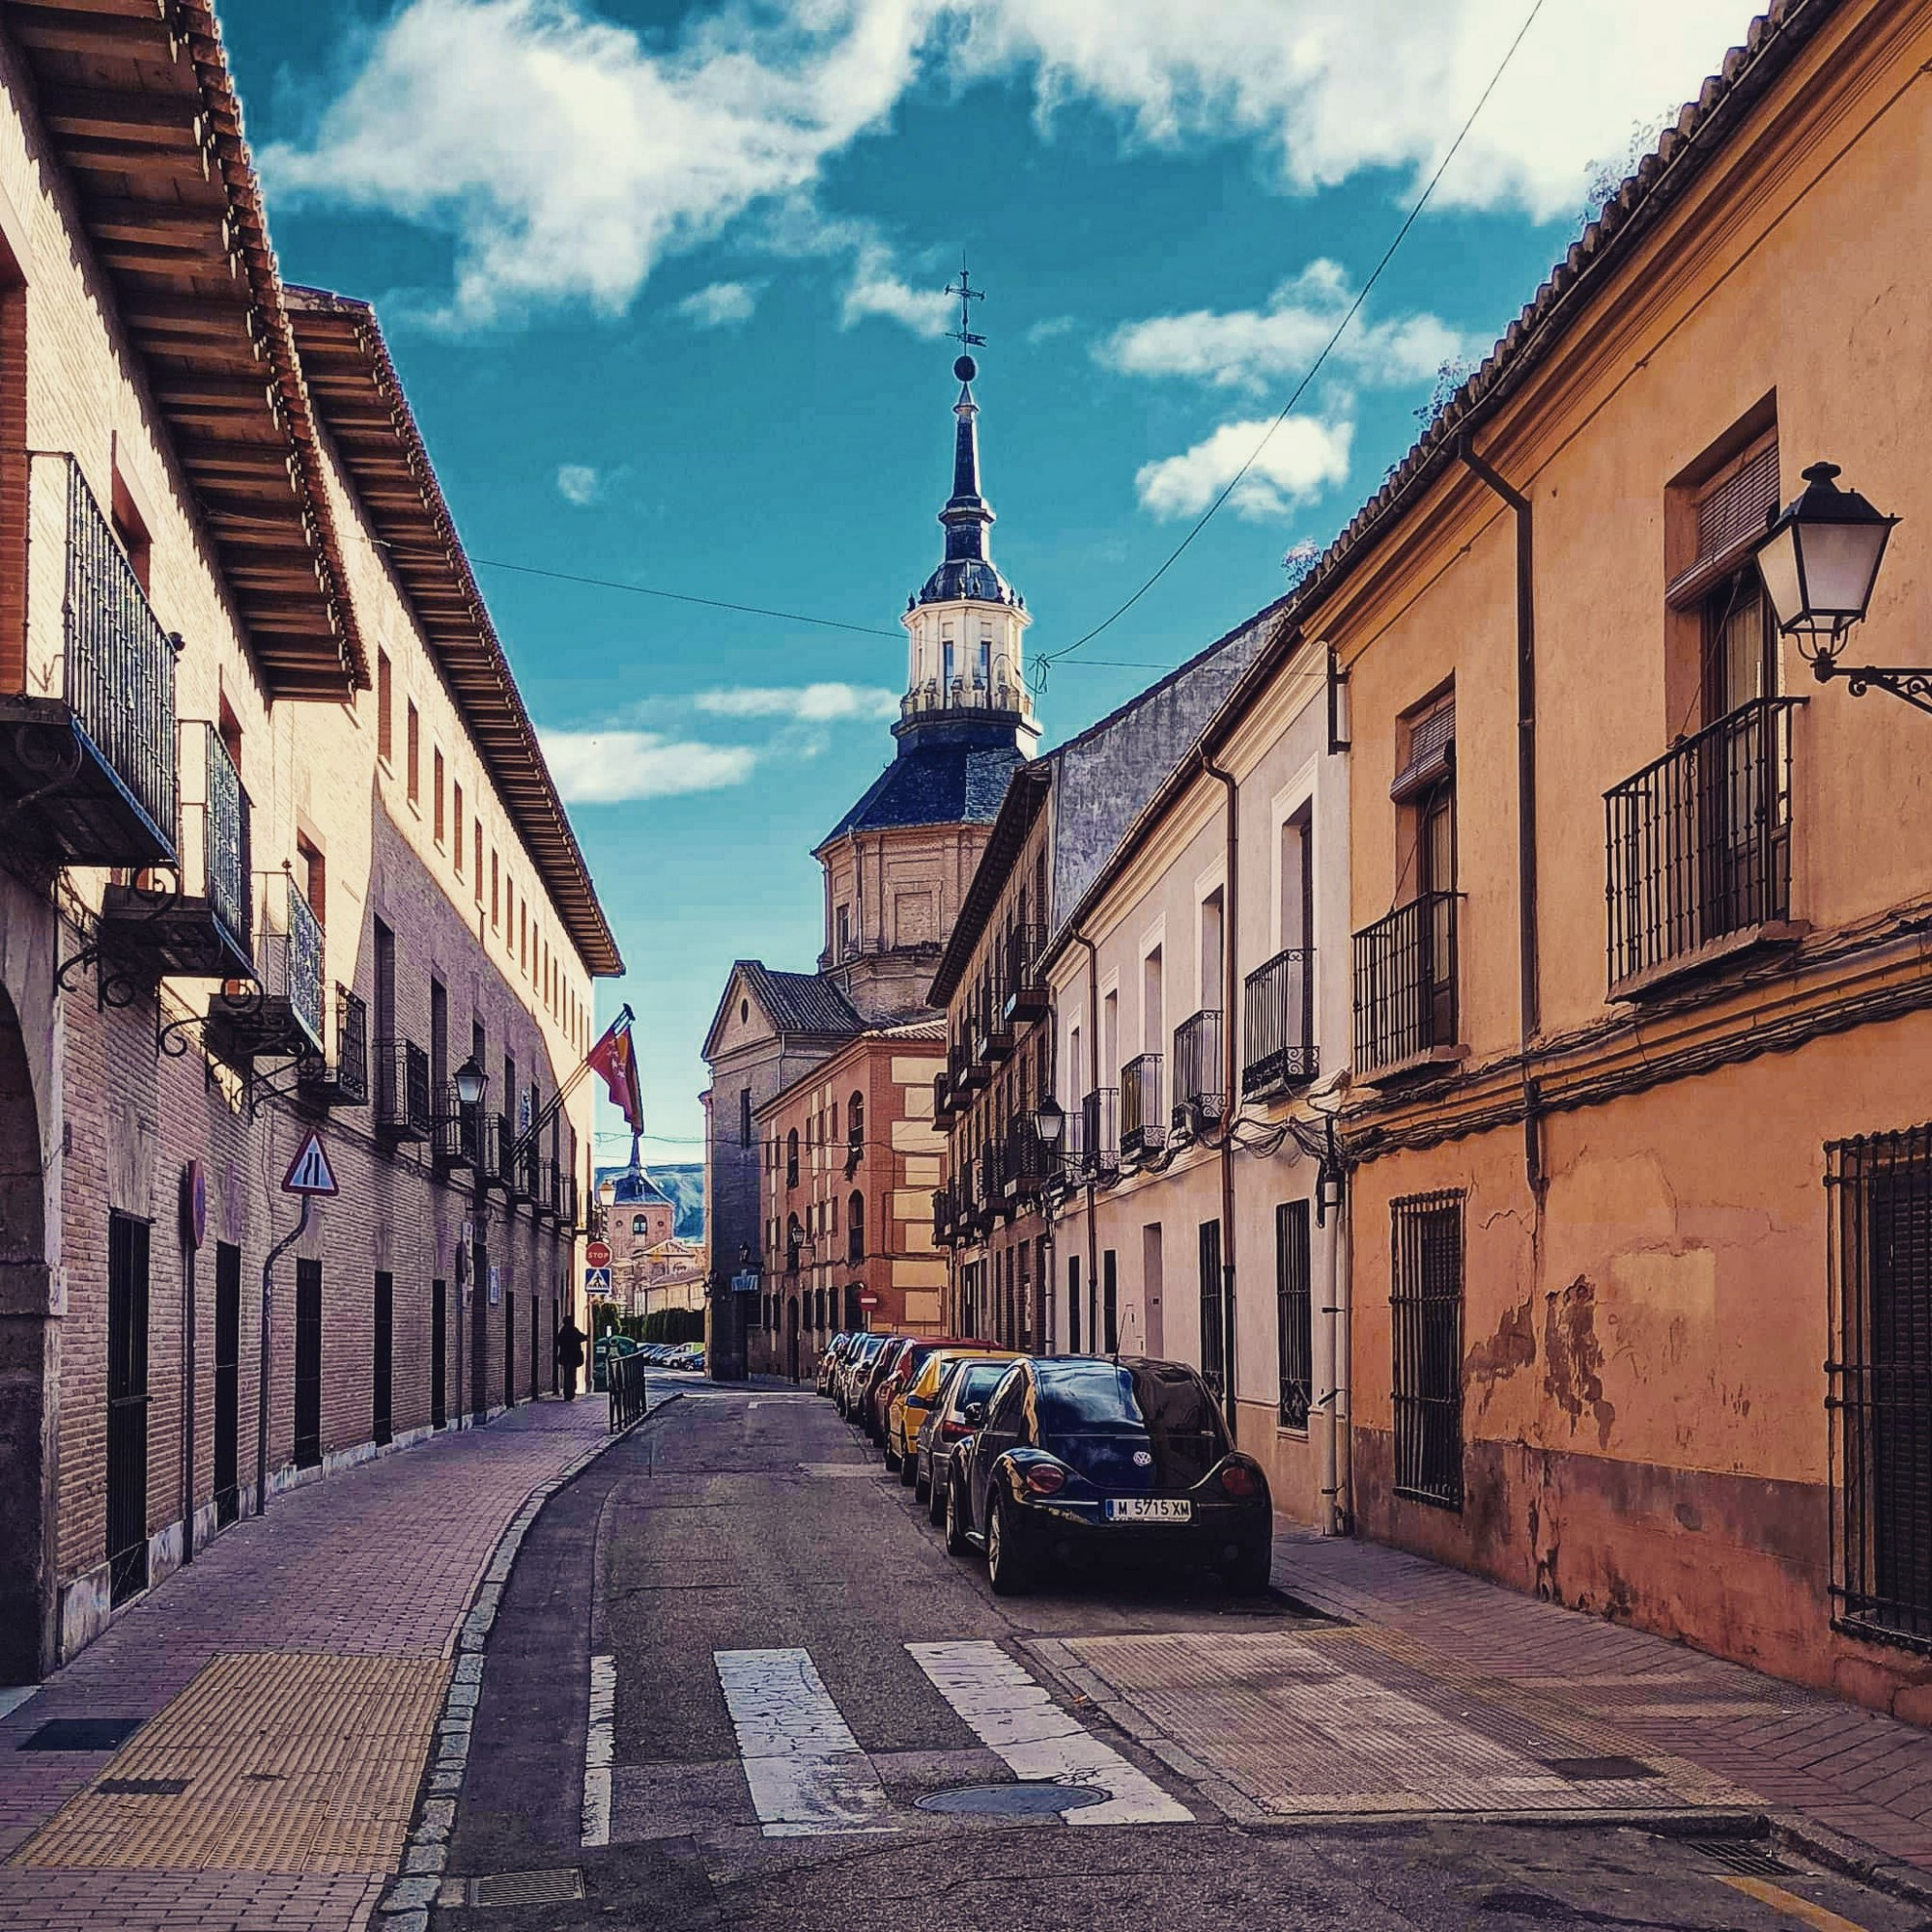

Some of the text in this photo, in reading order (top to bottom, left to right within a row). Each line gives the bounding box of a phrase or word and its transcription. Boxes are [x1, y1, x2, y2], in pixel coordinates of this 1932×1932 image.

[1119, 1501, 1189, 1516] M 5715 XM
